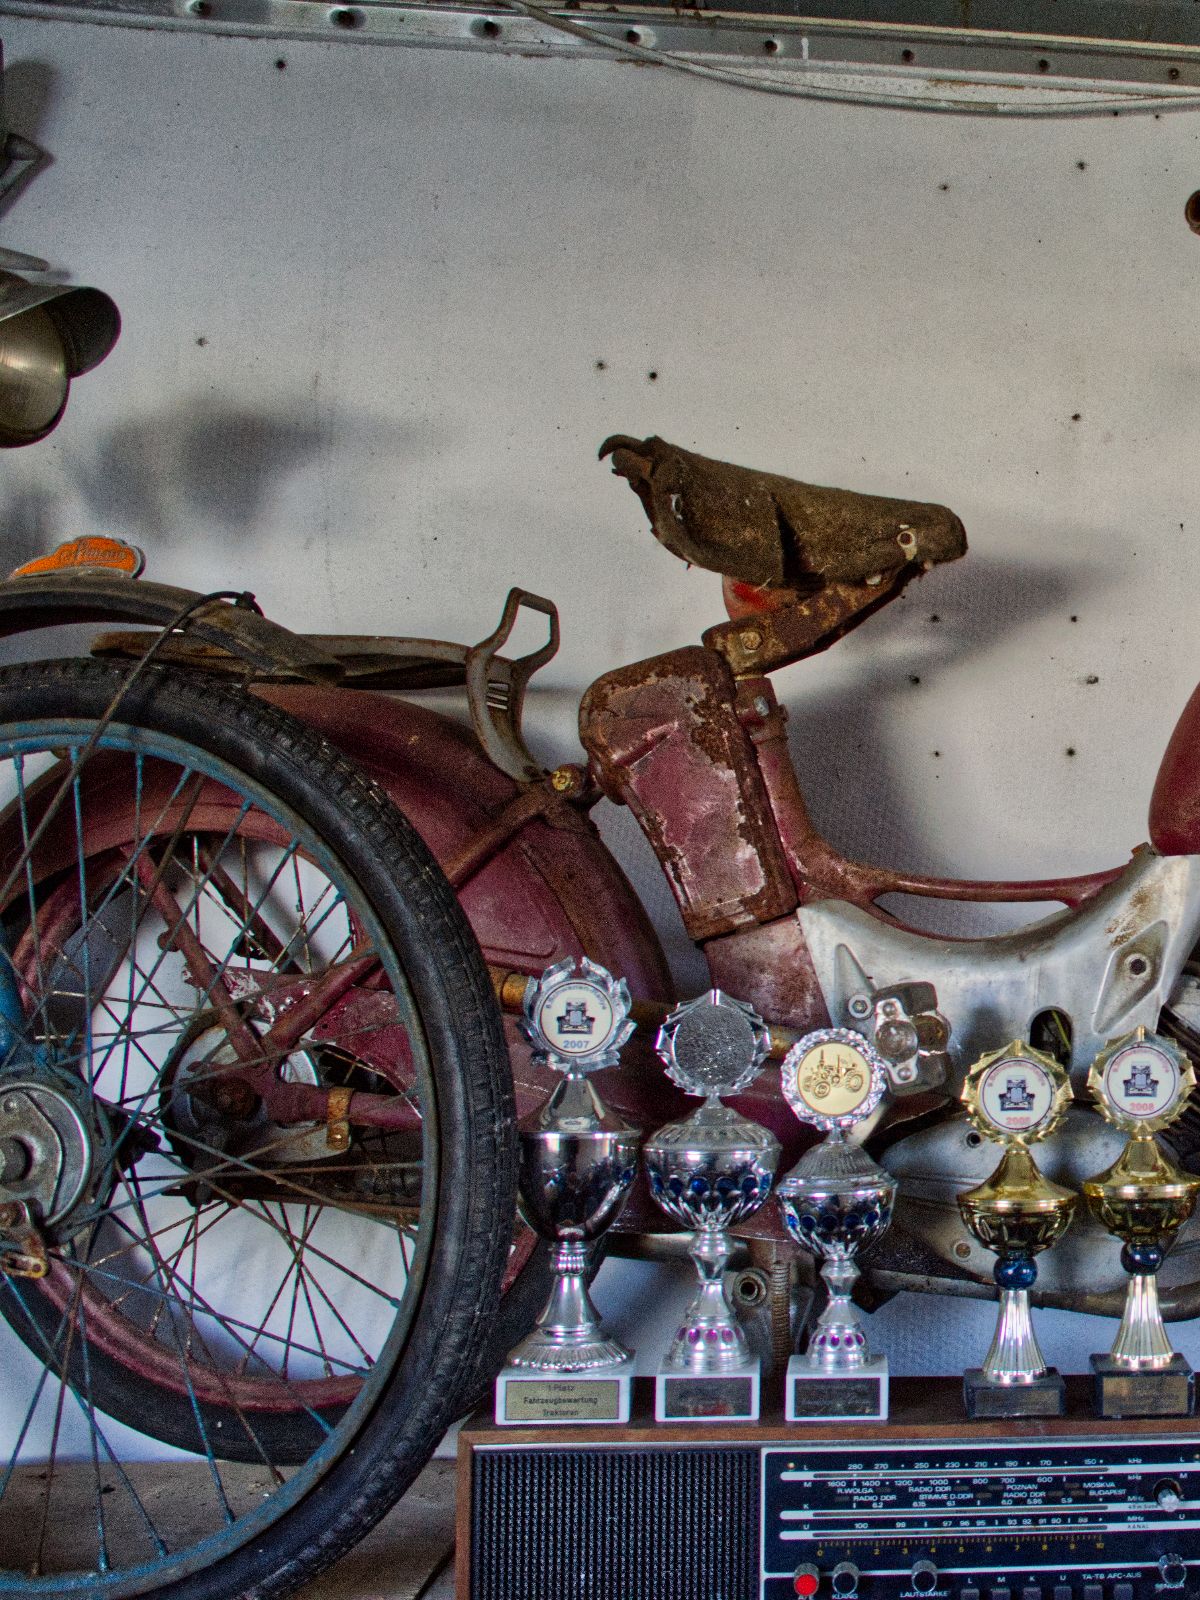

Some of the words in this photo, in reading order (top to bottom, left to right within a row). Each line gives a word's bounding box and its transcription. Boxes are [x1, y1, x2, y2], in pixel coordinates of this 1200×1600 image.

[563, 1040, 590, 1049] 2007
[523, 1396, 598, 1406] Fahrzeugbewertung
[1082, 1481, 1116, 1489] MOSKVA
[1003, 1491, 1028, 1499] RADIO
[854, 1522, 869, 1530] 100
[1106, 1571, 1142, 1580] AFC-AUS
